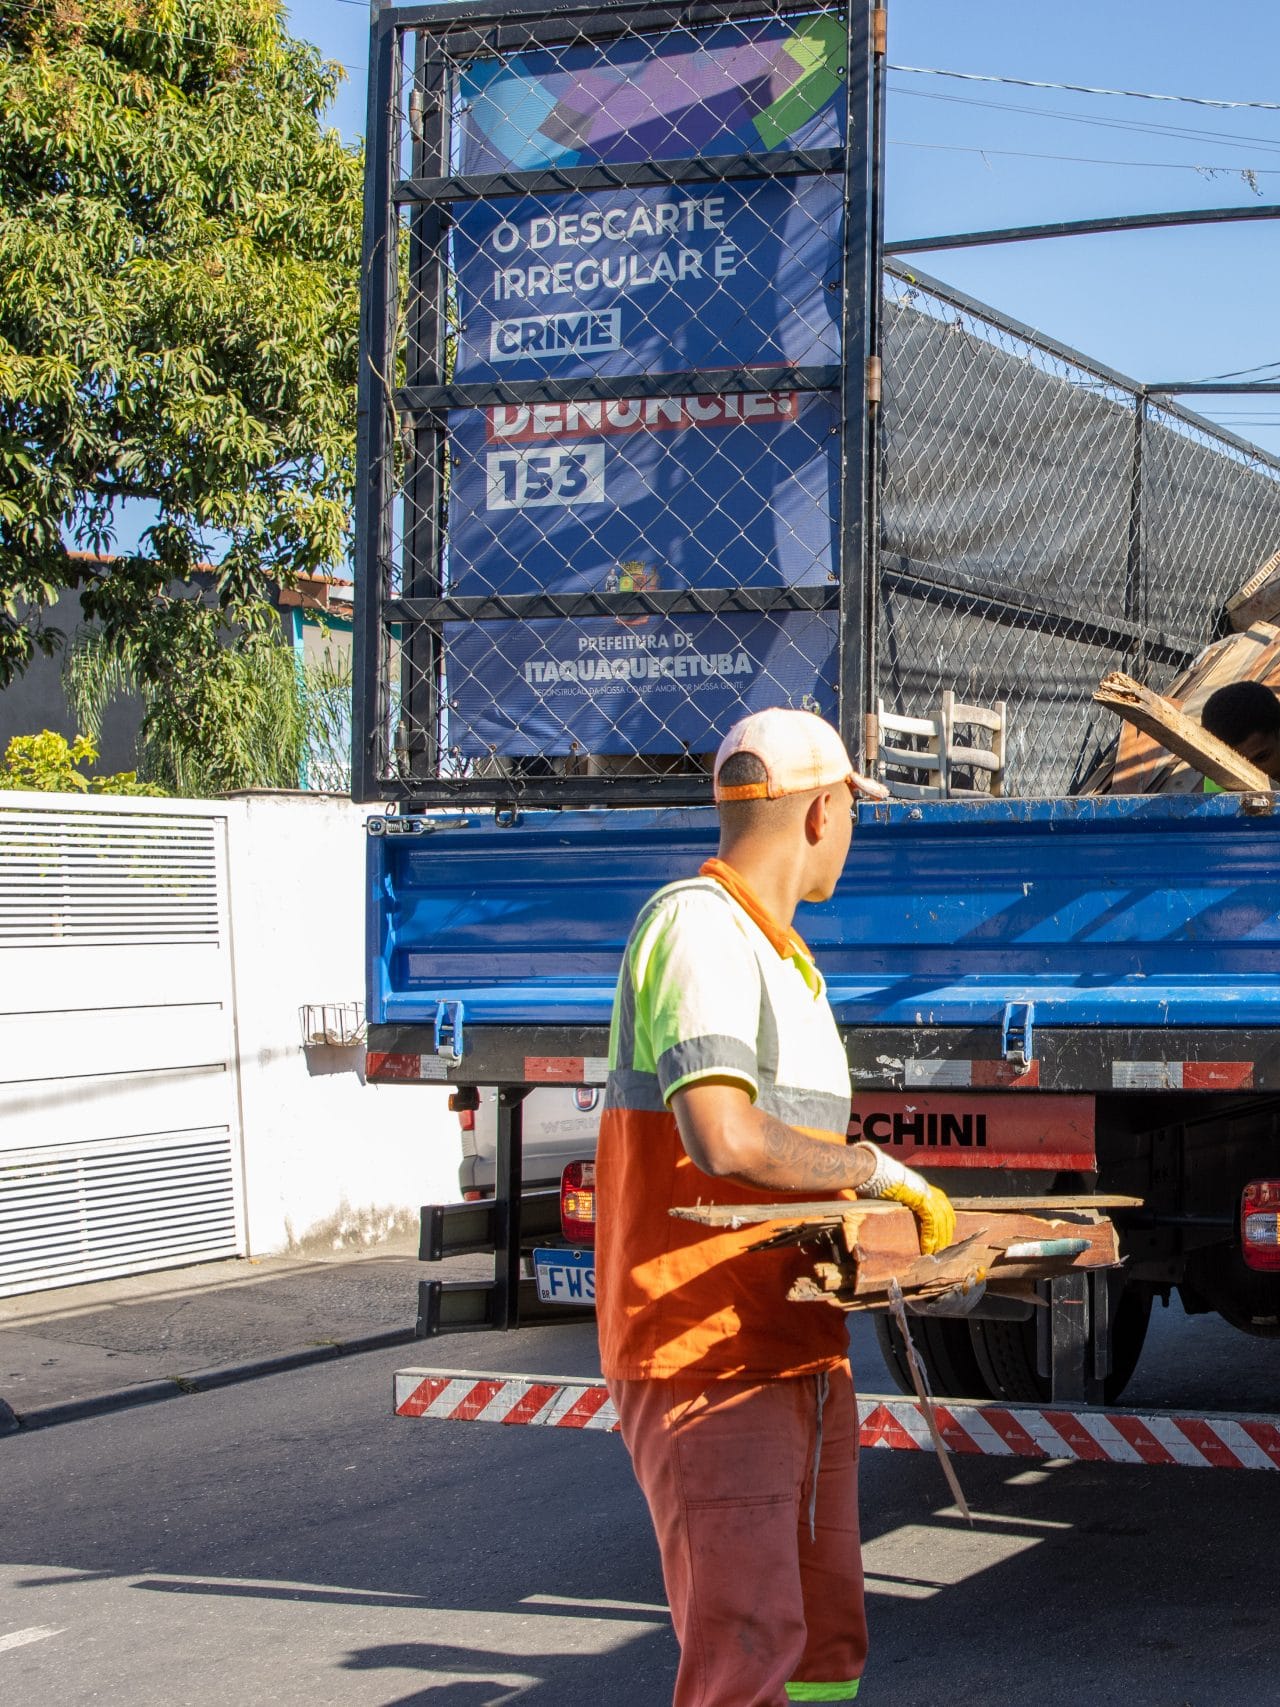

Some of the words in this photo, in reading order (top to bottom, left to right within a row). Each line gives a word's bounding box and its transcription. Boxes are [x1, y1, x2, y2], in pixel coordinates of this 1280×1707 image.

[492, 221, 519, 253] O
[530, 197, 725, 249] DESCARTE
[494, 249, 703, 300] IRREGULAR
[715, 236, 737, 277] É
[496, 313, 613, 354] CRIME
[498, 454, 588, 501] 153
[578, 634, 669, 652] PREFEITURA
[674, 632, 694, 648] DE
[525, 653, 753, 683] ITAQUAQUECETUBA
